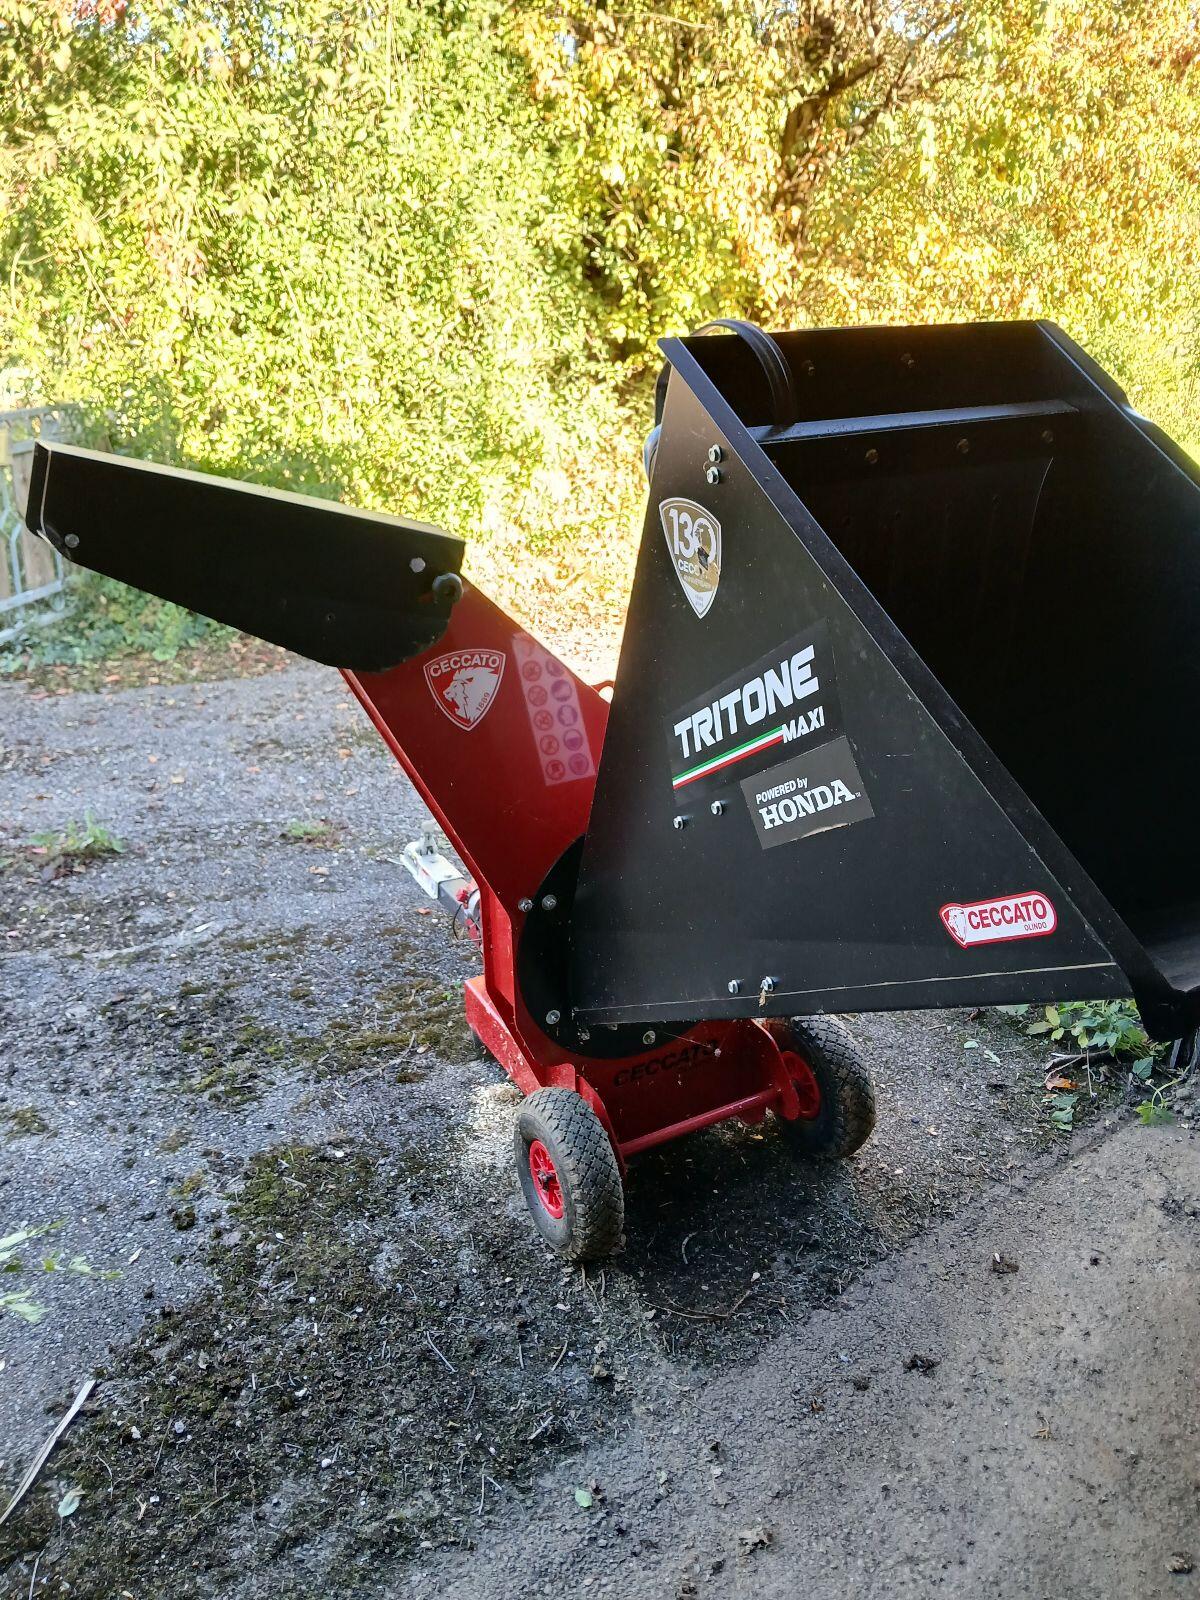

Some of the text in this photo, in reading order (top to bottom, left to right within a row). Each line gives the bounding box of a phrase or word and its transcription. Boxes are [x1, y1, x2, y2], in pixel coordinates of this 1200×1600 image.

[429, 654, 500, 677] CECCATO
[673, 644, 820, 759] TRITONE
[782, 705, 825, 744] MAXI
[755, 777, 808, 805] POWERED by
[758, 779, 856, 830] HONDA
[967, 899, 1048, 930] CECCATO
